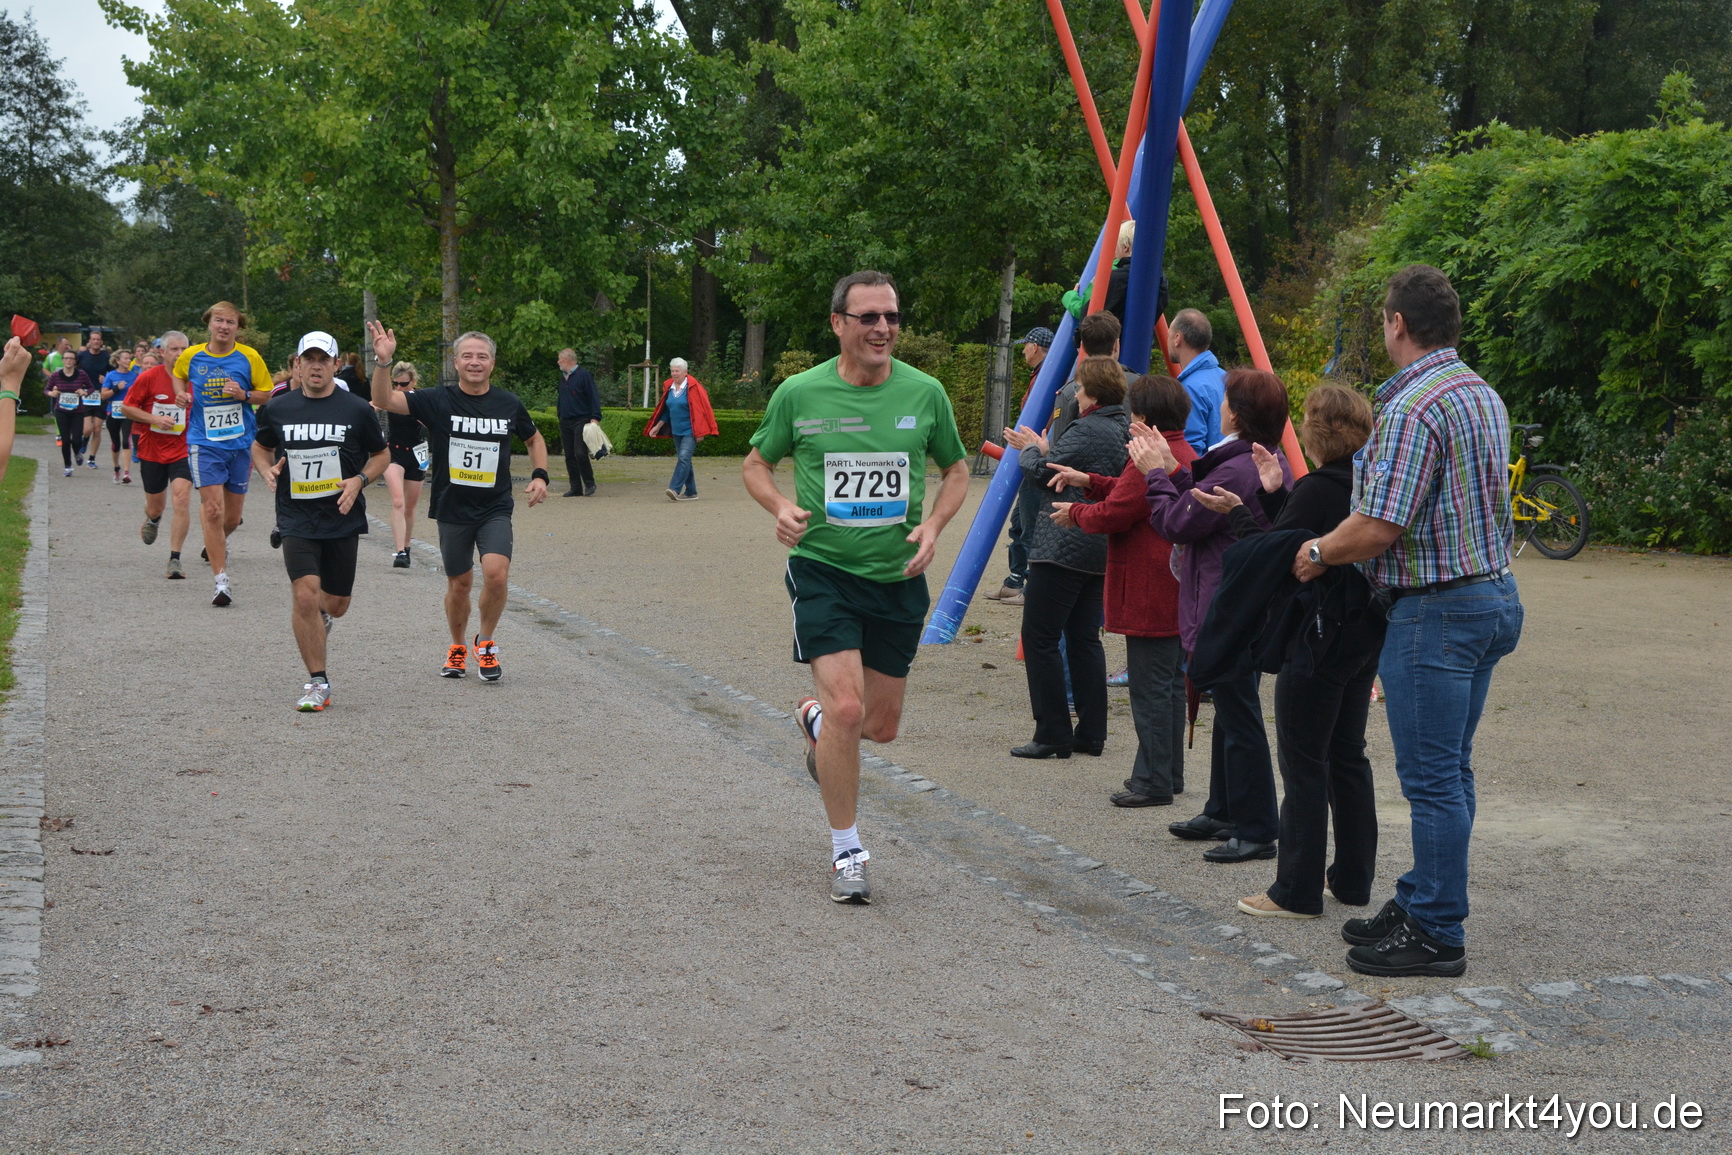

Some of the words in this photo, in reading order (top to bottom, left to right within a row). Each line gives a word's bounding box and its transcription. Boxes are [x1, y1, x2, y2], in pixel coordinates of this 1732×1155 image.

[208, 412, 240, 428] 2743
[450, 415, 508, 435] THULE
[282, 424, 347, 443] THULE
[451, 441, 467, 449] PARTL
[303, 452, 329, 460] Neumarkt
[463, 451, 482, 469] 51
[302, 461, 323, 480] 77
[826, 460, 854, 468] PARTL
[855, 459, 895, 467] Neumarkt
[459, 471, 483, 481] Oswald
[298, 482, 333, 492] Waldemar
[833, 470, 901, 498] 2729
[851, 505, 883, 517] Alfred
